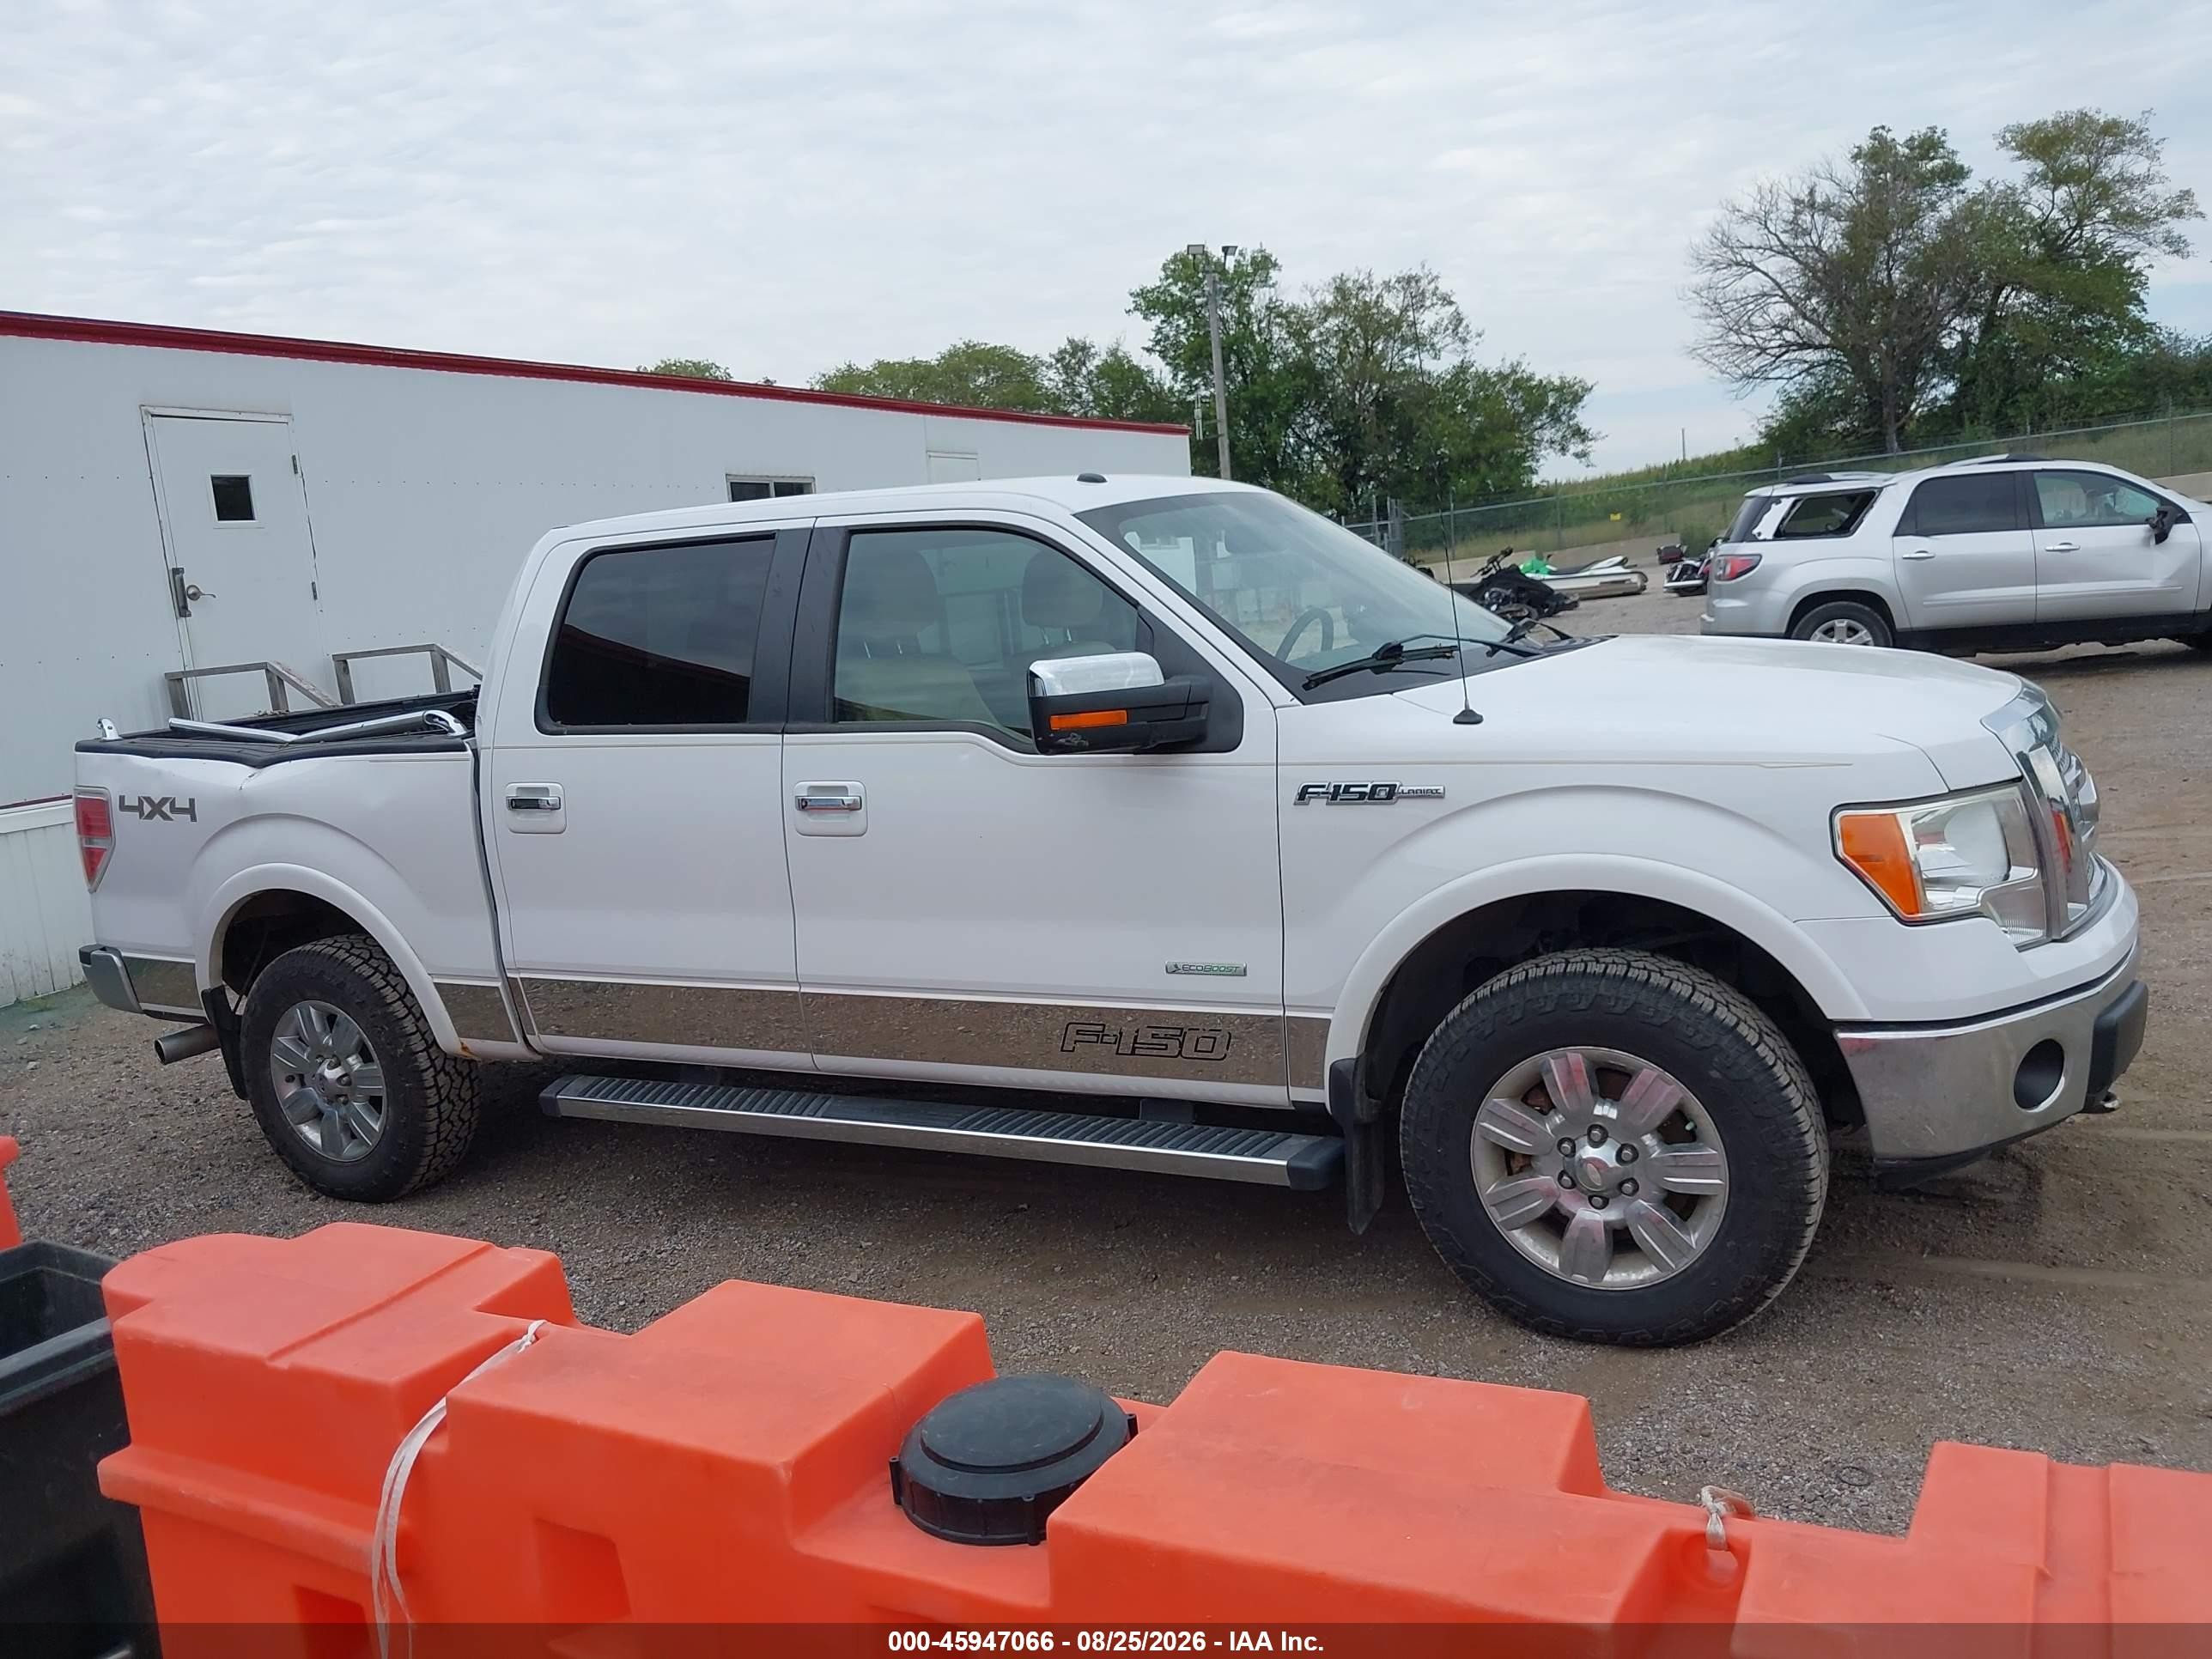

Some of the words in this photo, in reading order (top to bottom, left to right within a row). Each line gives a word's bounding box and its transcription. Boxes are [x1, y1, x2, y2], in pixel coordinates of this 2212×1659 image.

[1295, 781, 1401, 805] F-150
[118, 794, 198, 823] 4X4
[1182, 963, 1242, 974] ECOBOOST
[1060, 1022, 1232, 1061] F-150
